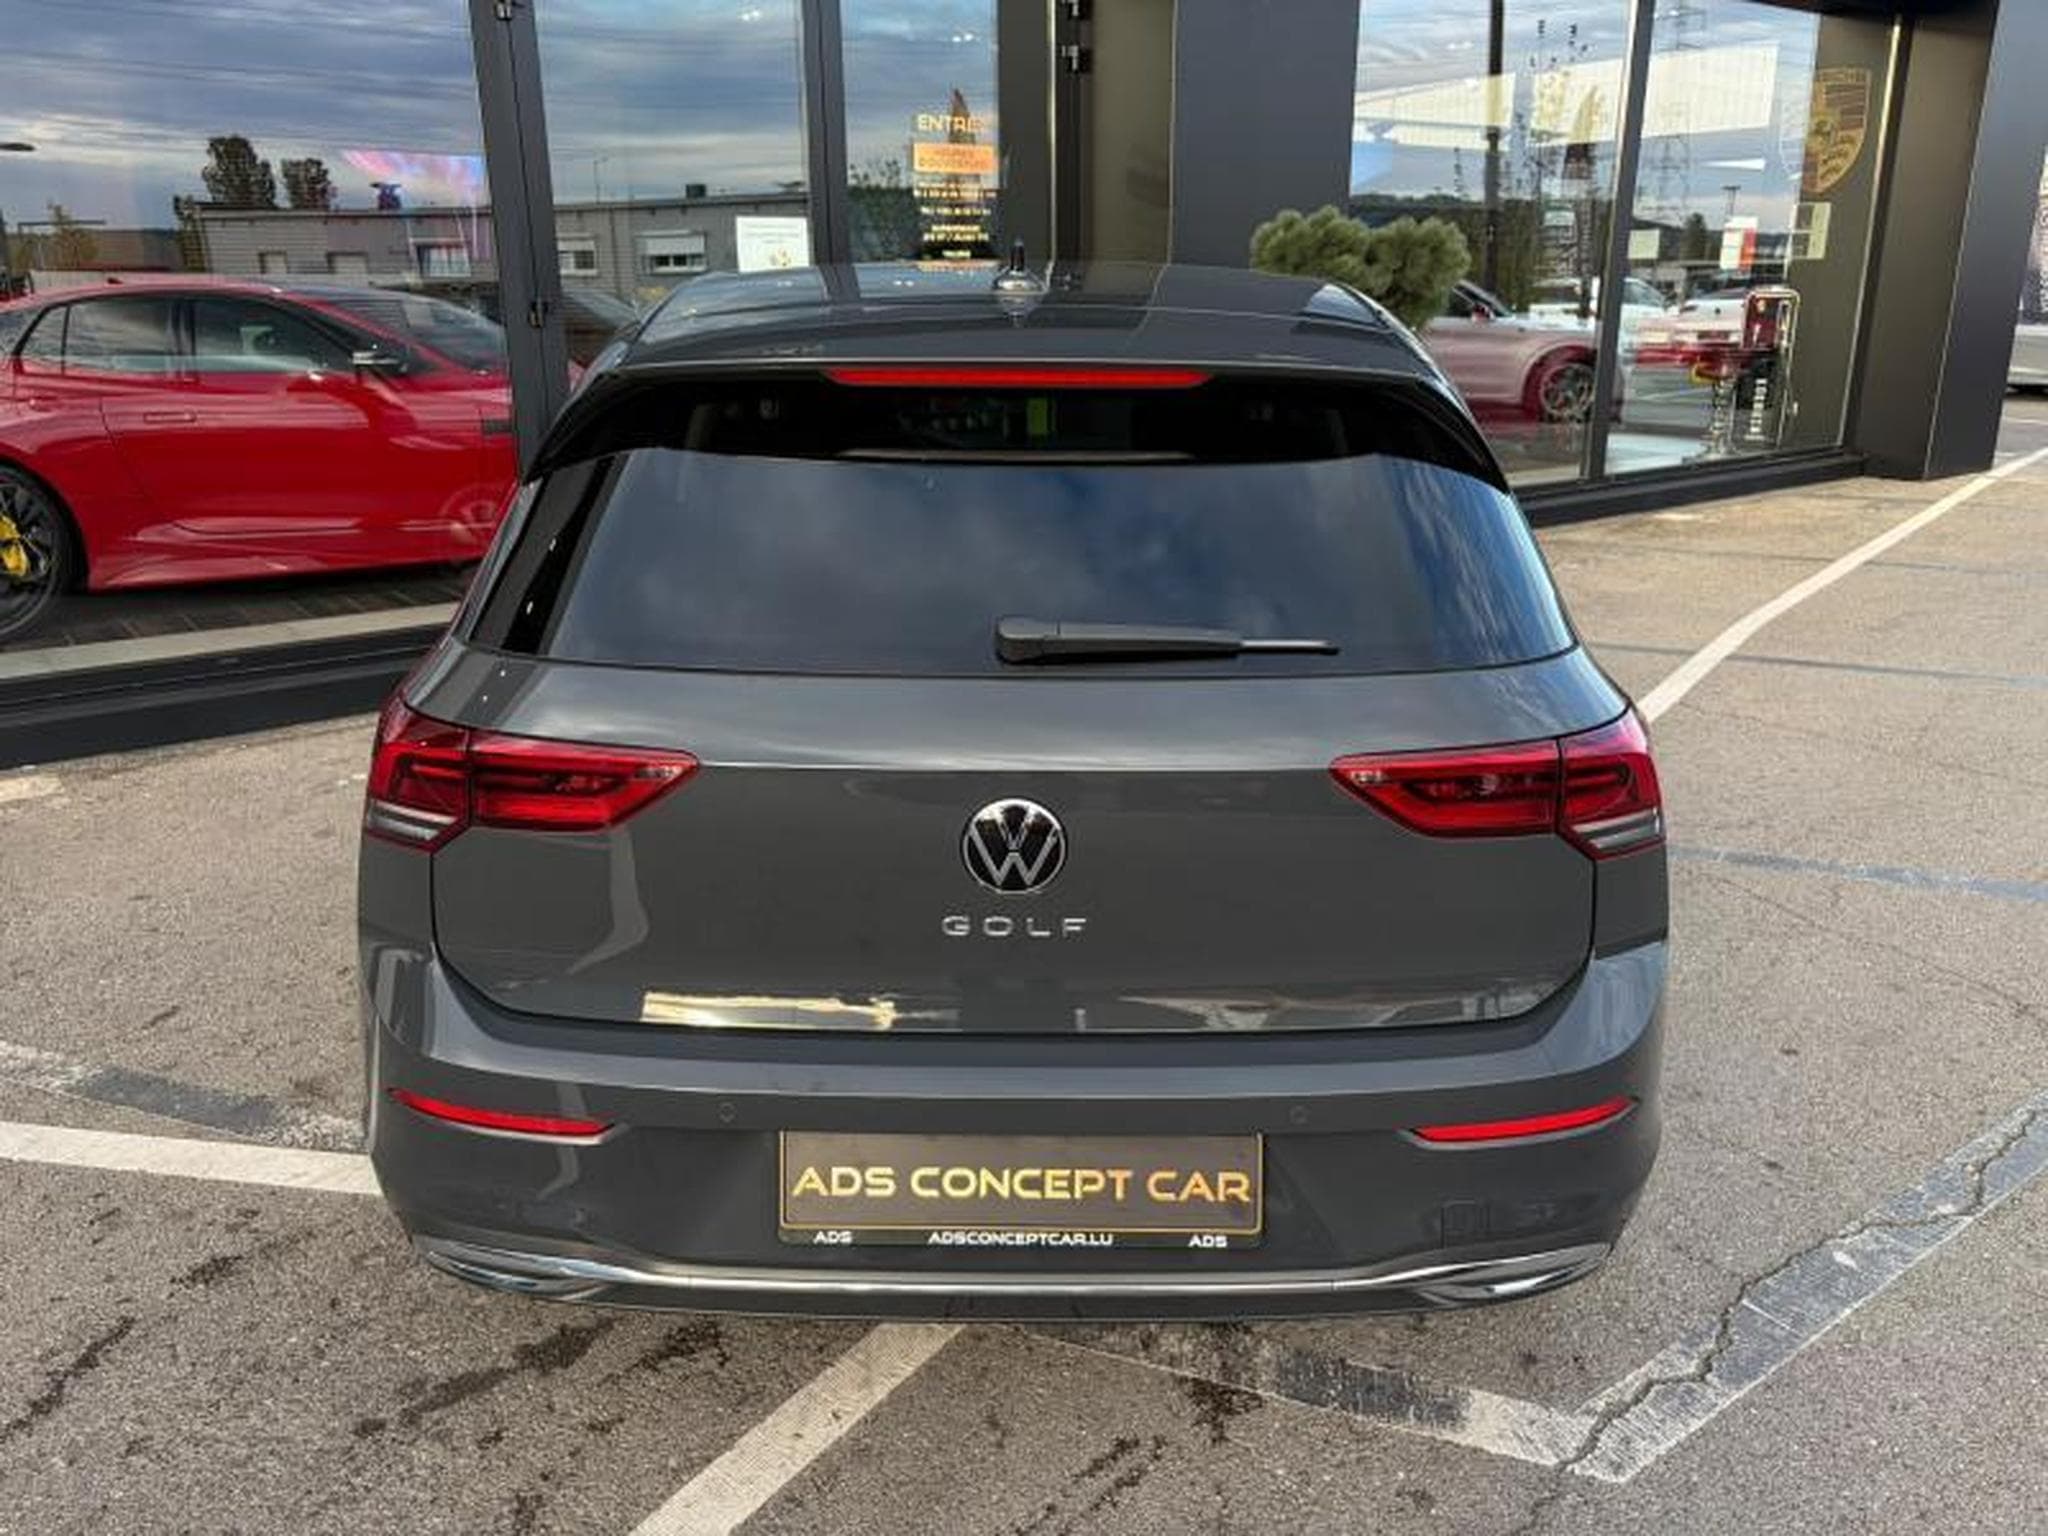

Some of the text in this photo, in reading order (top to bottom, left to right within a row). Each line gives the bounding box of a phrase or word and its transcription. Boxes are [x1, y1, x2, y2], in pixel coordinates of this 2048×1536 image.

[942, 915, 1087, 937] GOLF
[792, 1166, 1250, 1202] ADS CONCEPT CAR
[813, 1231, 1228, 1249] ADS ADSCONCEPTCAR.LU ADS
